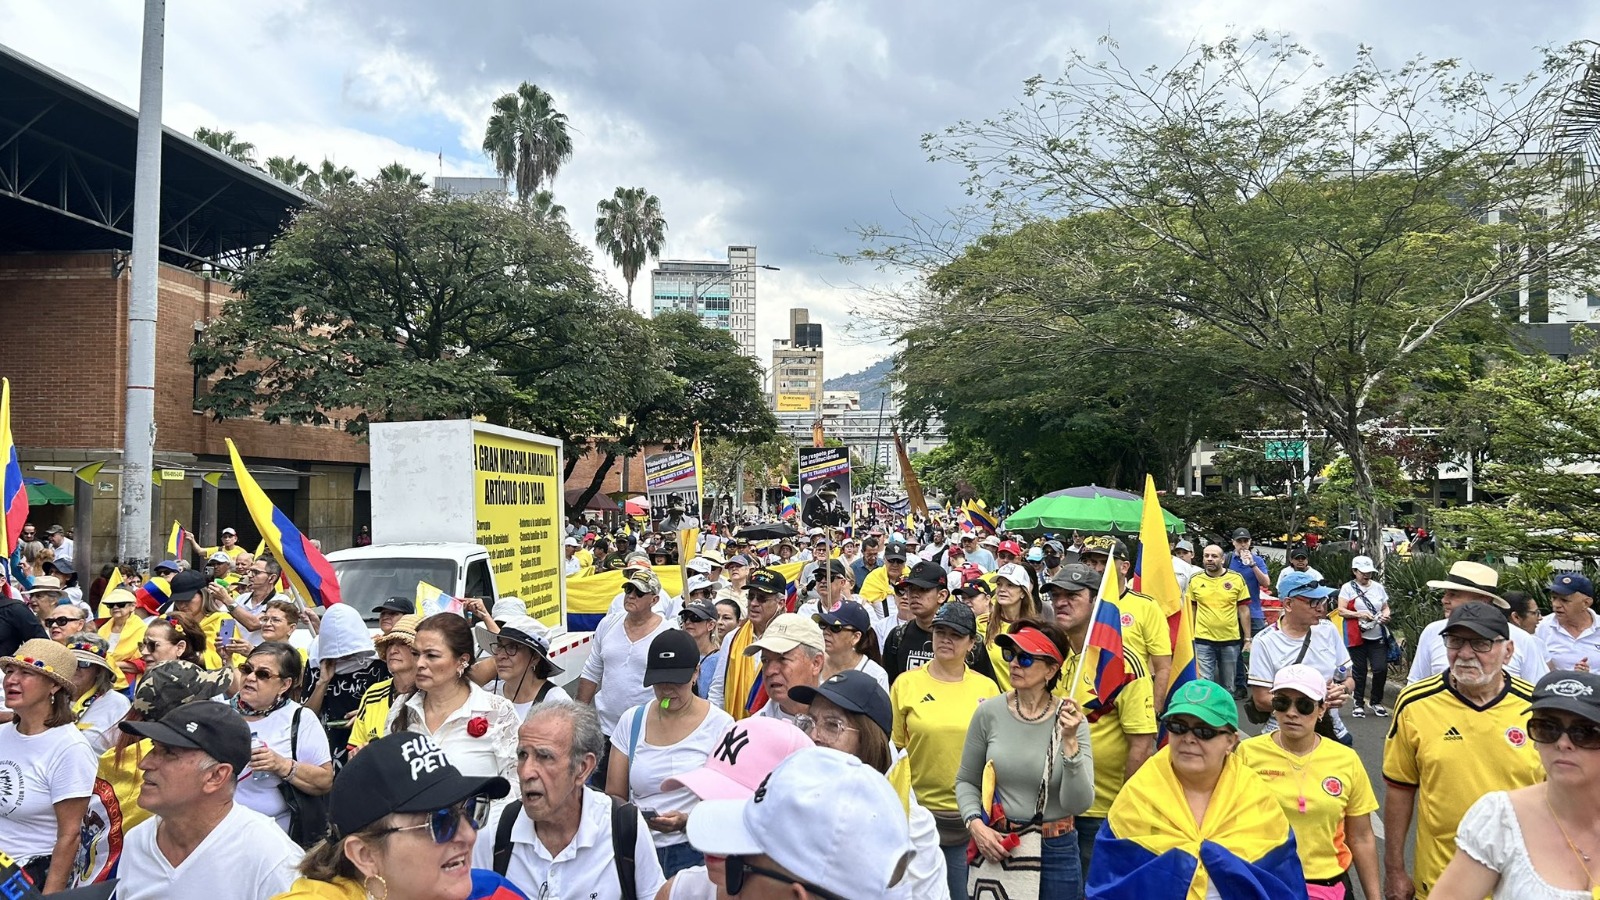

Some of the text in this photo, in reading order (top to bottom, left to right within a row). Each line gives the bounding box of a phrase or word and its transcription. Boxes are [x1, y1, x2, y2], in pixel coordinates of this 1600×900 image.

[479, 445, 498, 472] GRAN
[500, 448, 527, 475] MARCHA
[528, 452, 554, 476] AMARILLA
[809, 451, 827, 460] respeto
[828, 448, 836, 456] por
[809, 453, 839, 465] instituciones
[485, 476, 517, 505] ARTÍCULO
[519, 482, 530, 505] 109
